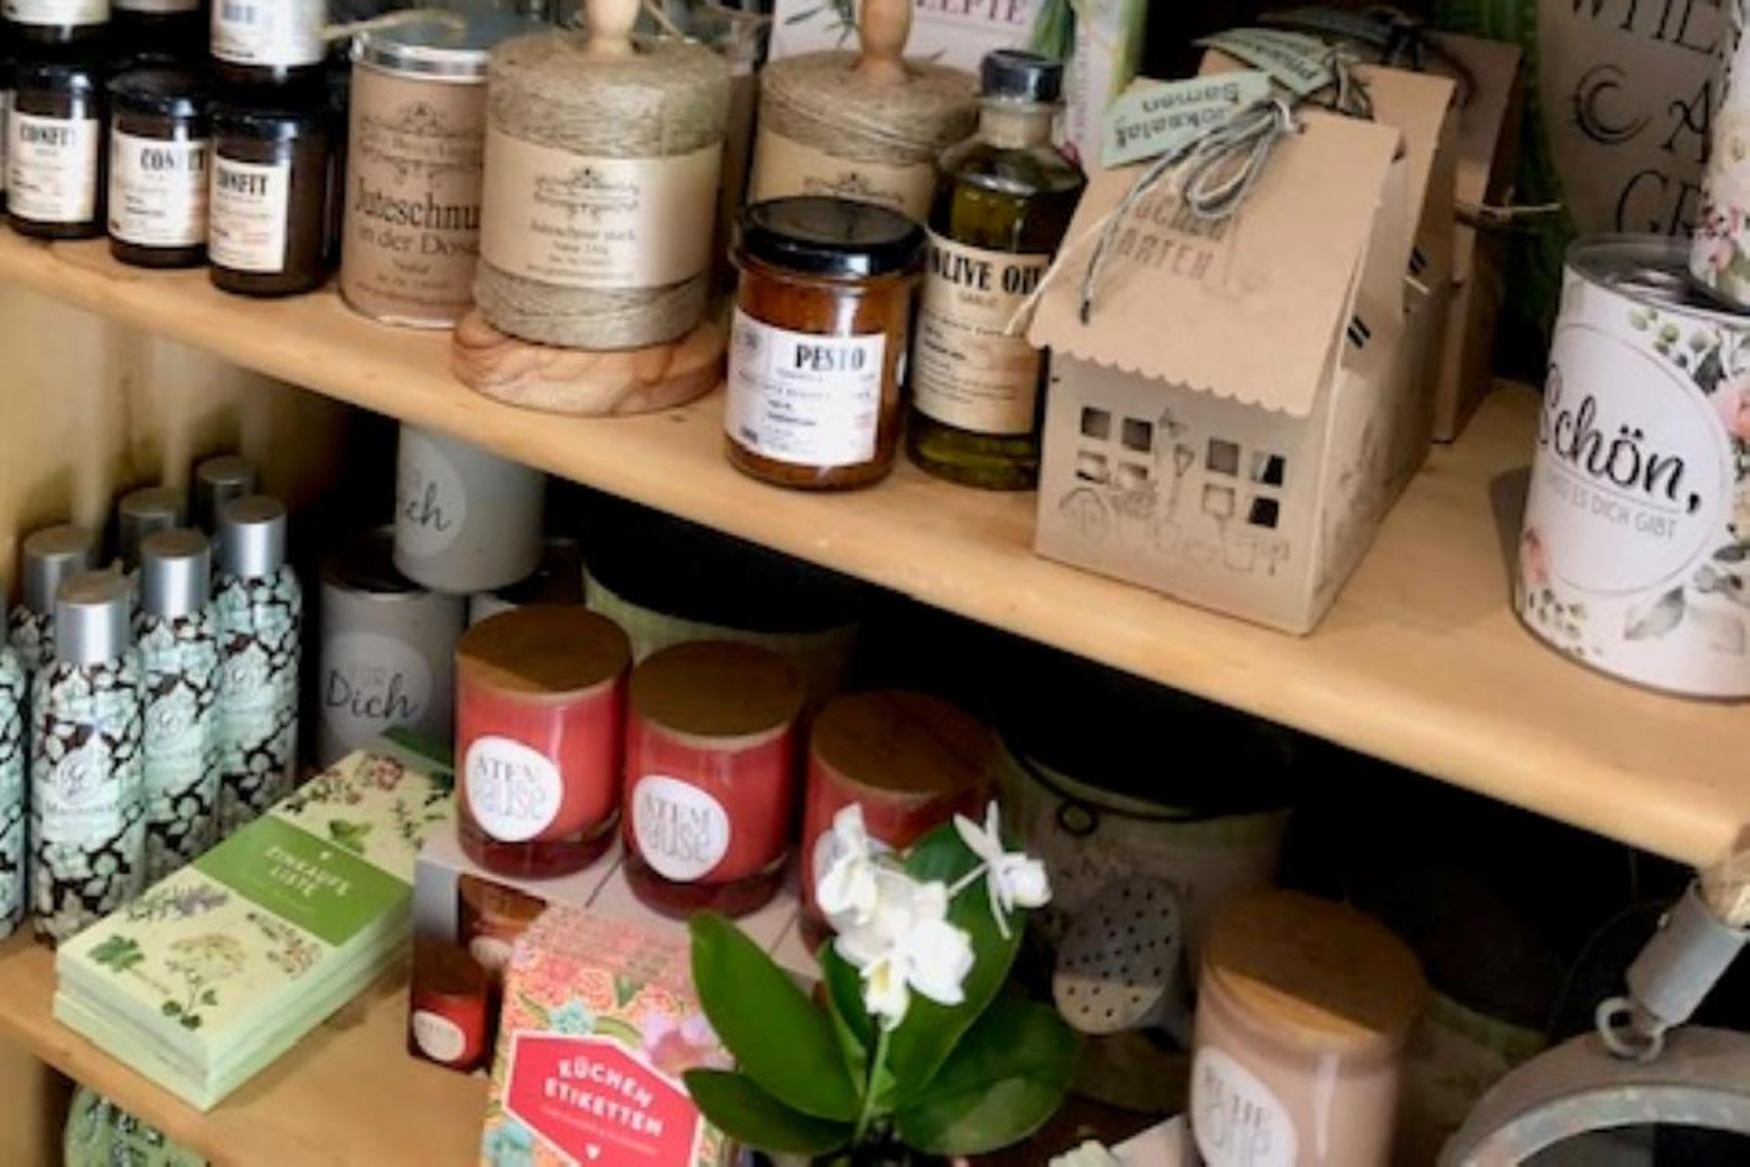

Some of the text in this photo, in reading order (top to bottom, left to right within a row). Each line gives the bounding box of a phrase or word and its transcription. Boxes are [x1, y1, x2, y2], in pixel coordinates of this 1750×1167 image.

[795, 344, 866, 372] PESTO
[326, 667, 418, 720] Dich
[544, 1075, 664, 1137] ETIKETTEN
[557, 1055, 653, 1108] KÜCHEN
